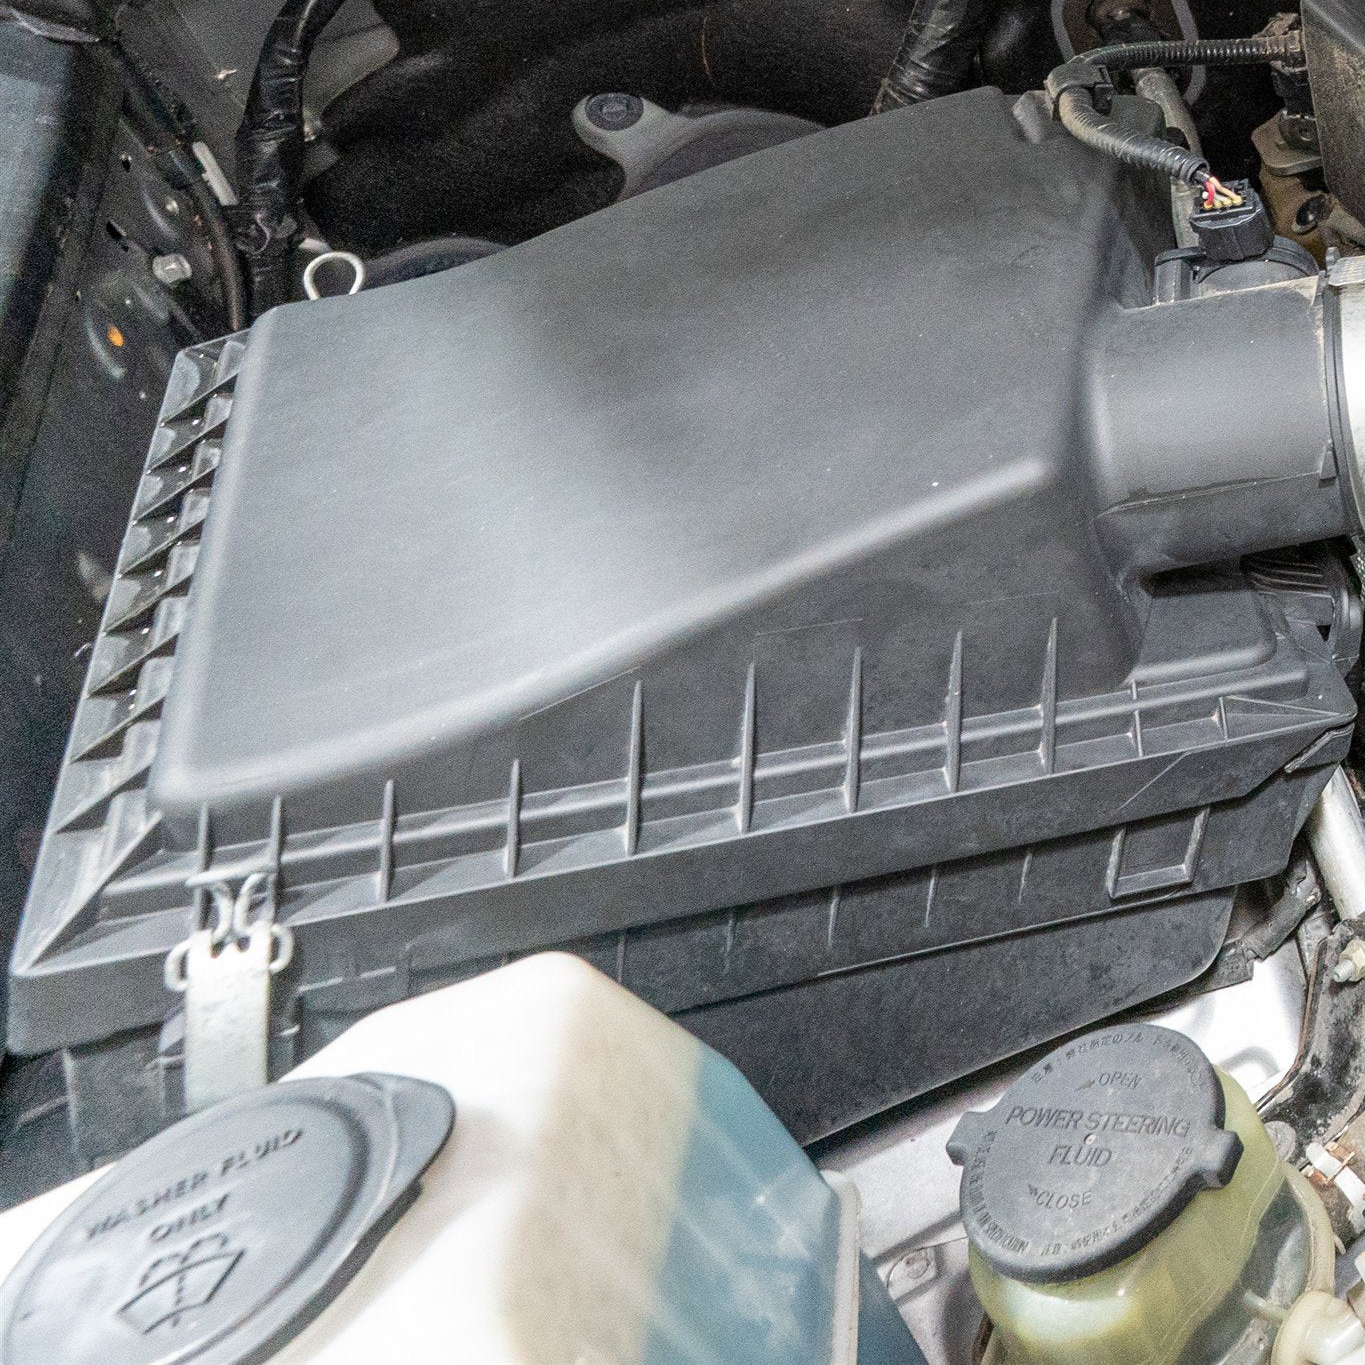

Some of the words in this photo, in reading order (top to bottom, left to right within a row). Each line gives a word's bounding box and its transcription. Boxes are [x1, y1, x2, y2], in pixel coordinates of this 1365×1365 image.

[1099, 1071, 1145, 1090] OPEN
[1005, 1105, 1085, 1131] POWER
[1085, 1111, 1191, 1138] STEERING
[1046, 1144, 1113, 1168] FLUID
[86, 1171, 209, 1241] WASHER
[219, 1128, 304, 1178] FLUID
[1035, 1189, 1093, 1211] CLOSE
[150, 1191, 231, 1243] ONLY
